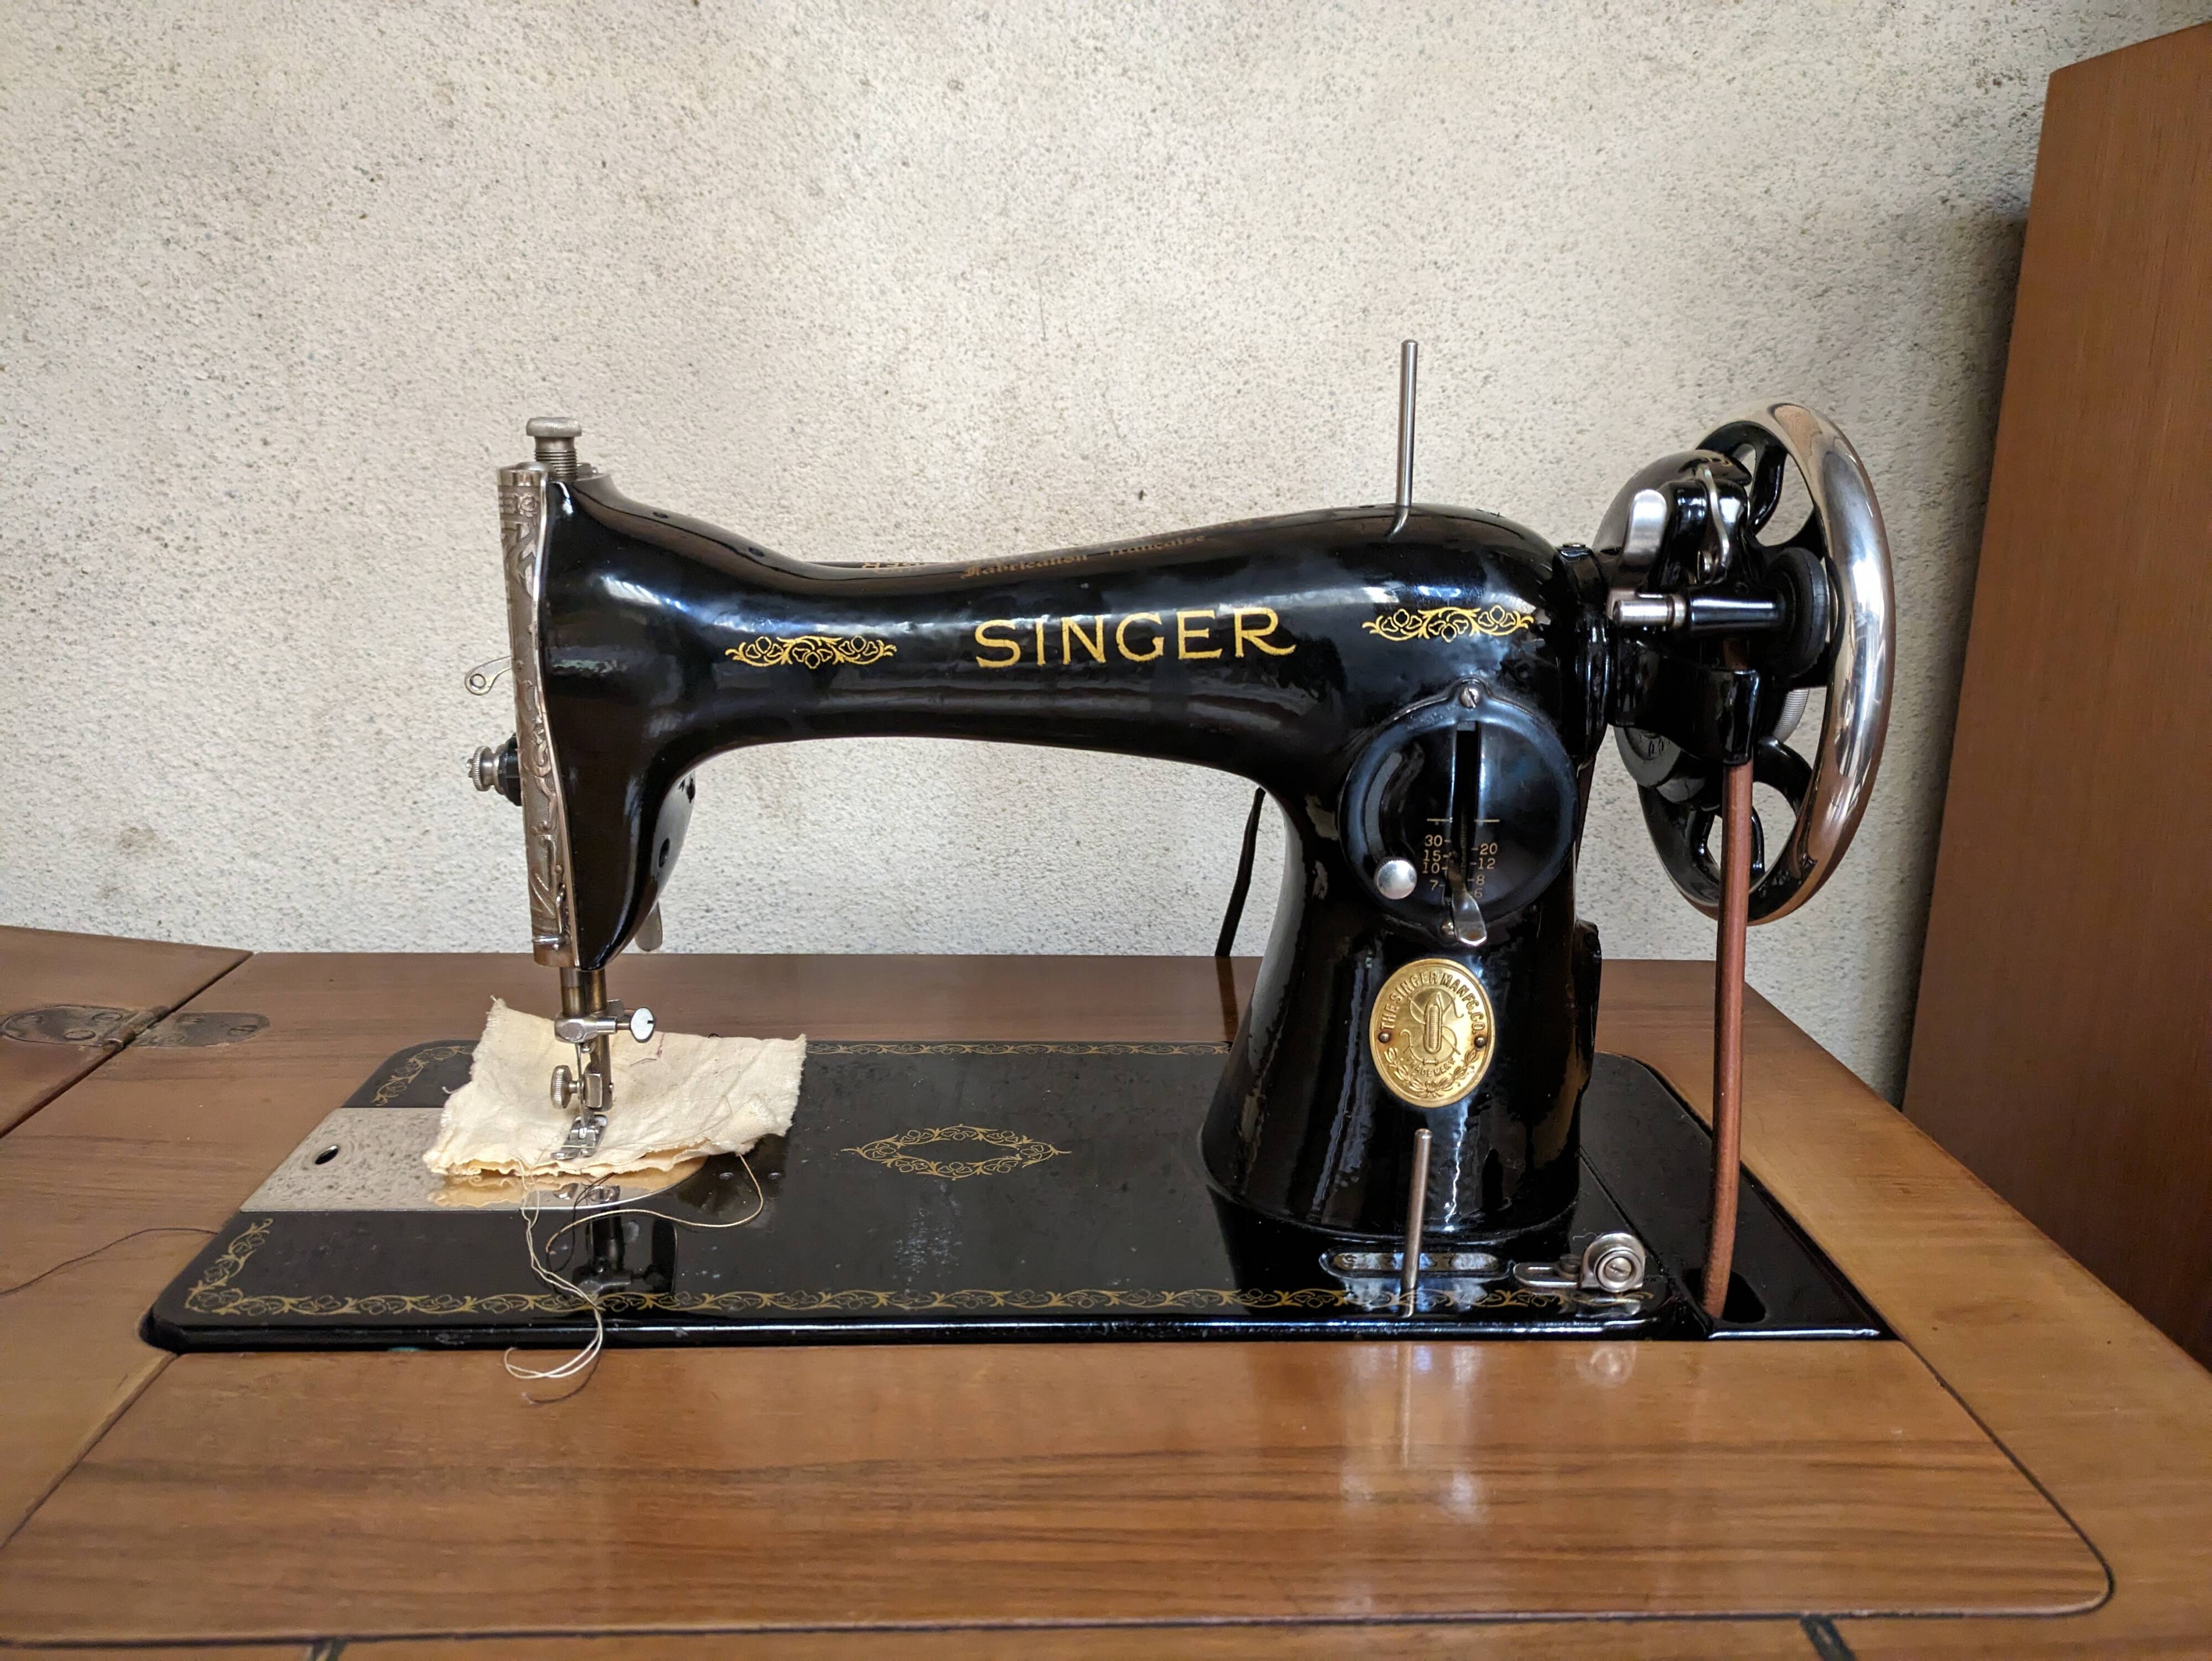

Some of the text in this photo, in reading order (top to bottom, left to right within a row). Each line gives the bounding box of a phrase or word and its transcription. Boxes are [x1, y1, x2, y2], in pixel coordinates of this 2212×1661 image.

[974, 607, 1297, 668] SINGER
[1425, 834, 1443, 847] 30
[1479, 842, 1498, 855] 20
[1423, 849, 1441, 862] 15
[1422, 862, 1440, 874] 10
[1478, 857, 1495, 869] 12
[1430, 879, 1438, 891] 7
[1475, 874, 1485, 886] 8
[1474, 888, 1483, 898] 6
[1389, 970, 1439, 1004] SINGER
[1380, 1002, 1400, 1030] THE
